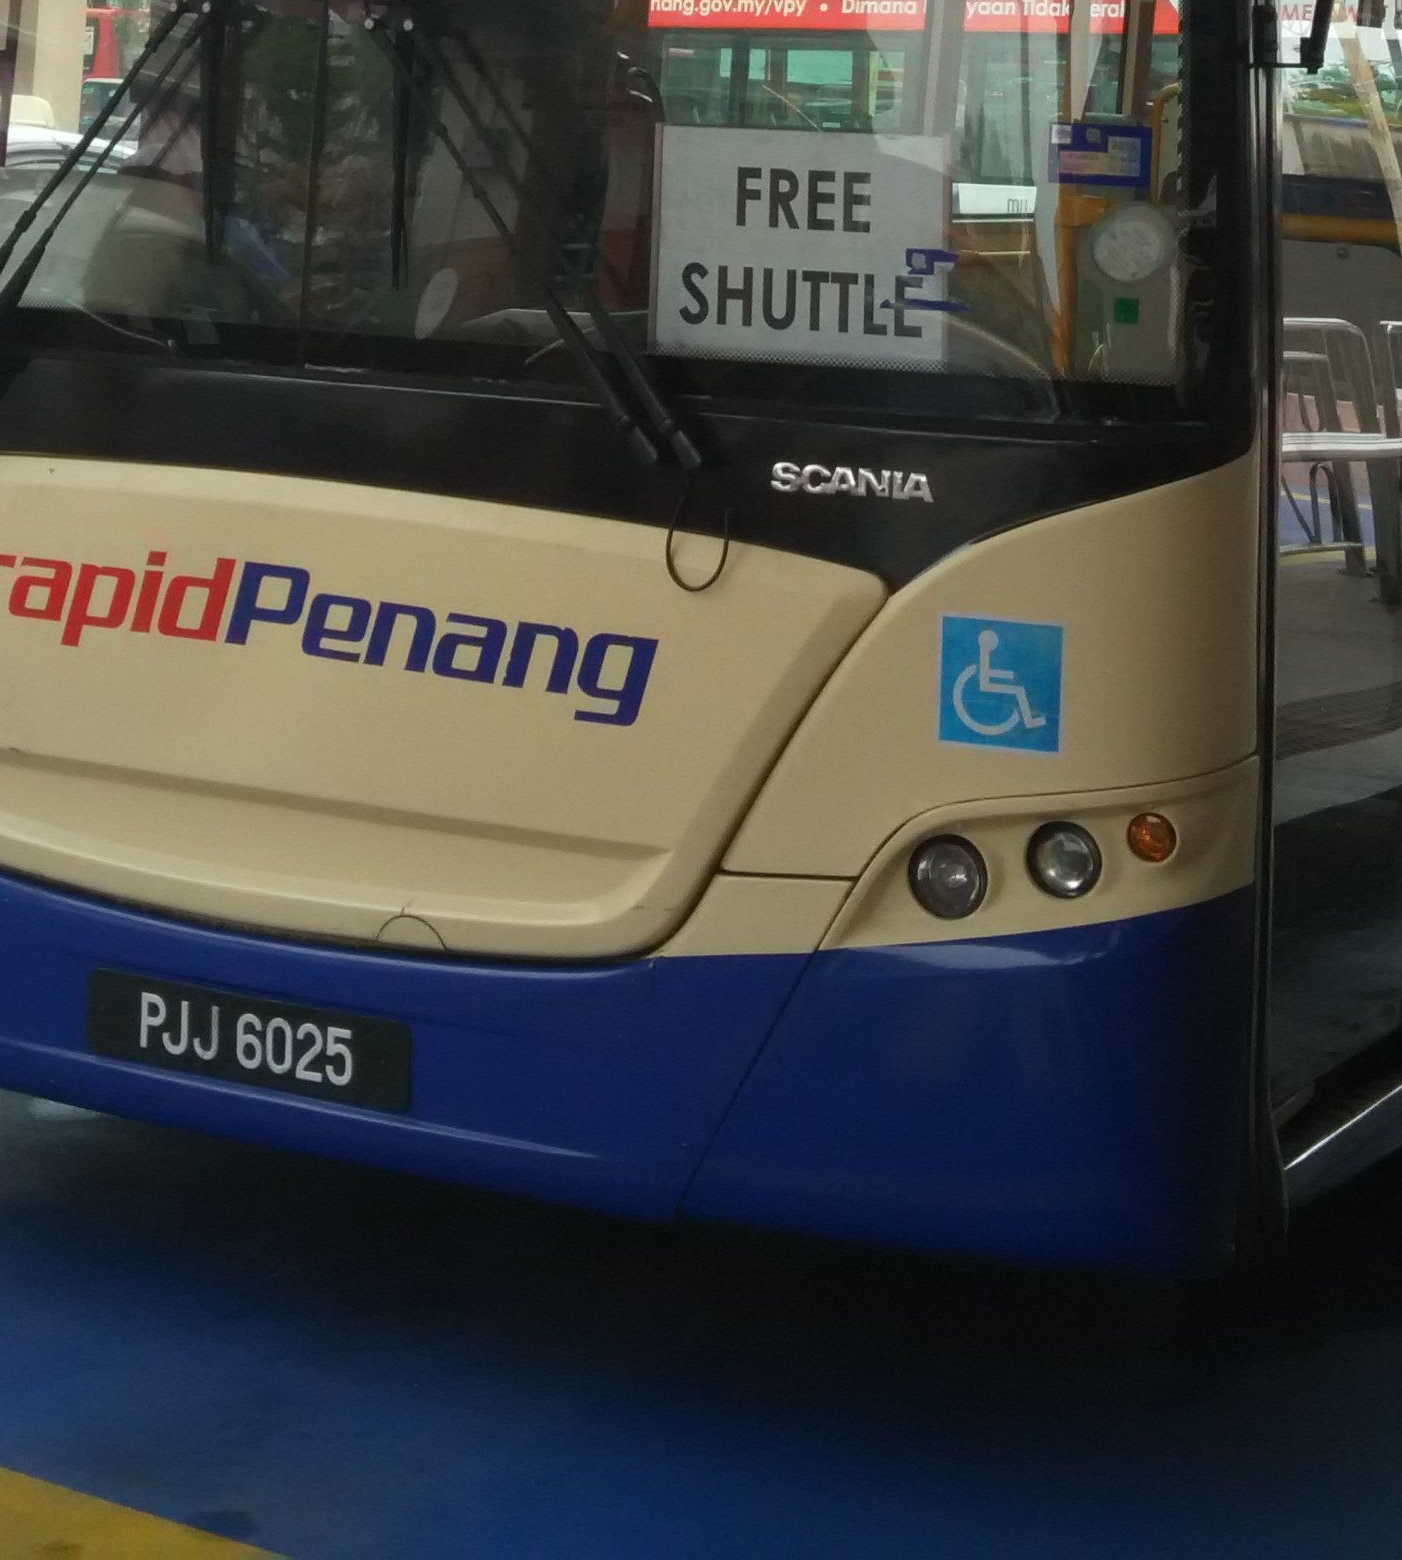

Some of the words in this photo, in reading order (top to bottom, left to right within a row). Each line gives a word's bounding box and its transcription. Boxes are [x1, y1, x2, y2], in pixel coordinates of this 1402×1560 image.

[735, 166, 872, 234] FREE
[678, 261, 924, 339] SHUTTLE
[770, 461, 935, 503] SCANIA
[139, 991, 220, 1061] PJJ
[235, 1012, 354, 1087] 6025
